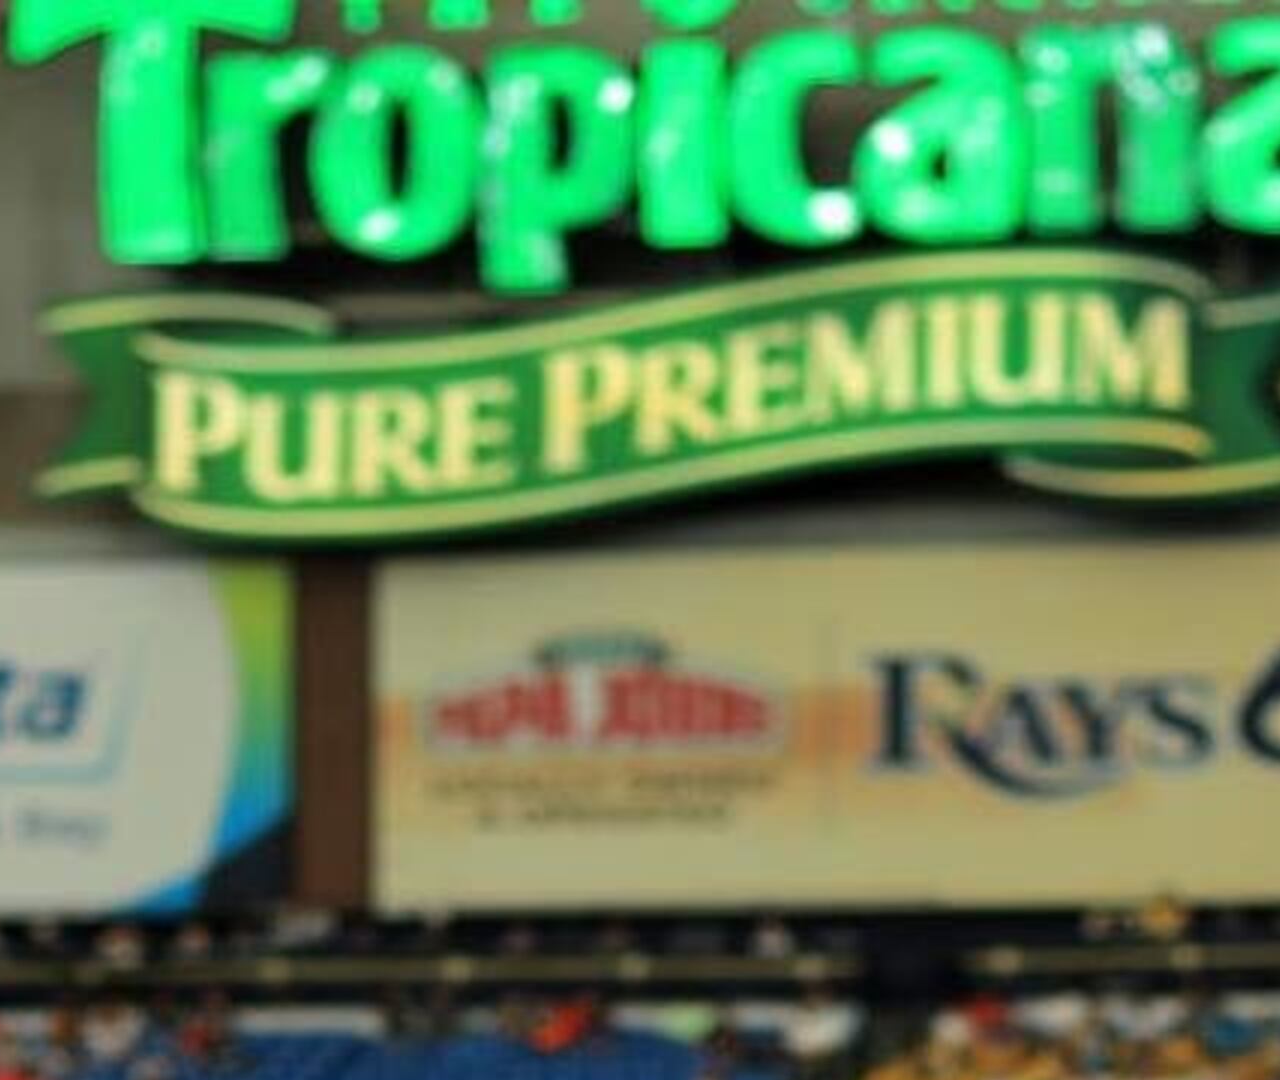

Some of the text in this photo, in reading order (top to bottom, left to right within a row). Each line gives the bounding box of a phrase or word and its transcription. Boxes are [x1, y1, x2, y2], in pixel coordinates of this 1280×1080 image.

[152, 292, 1190, 502] PURE PREMIUM
[865, 650, 1215, 800] RAYS
